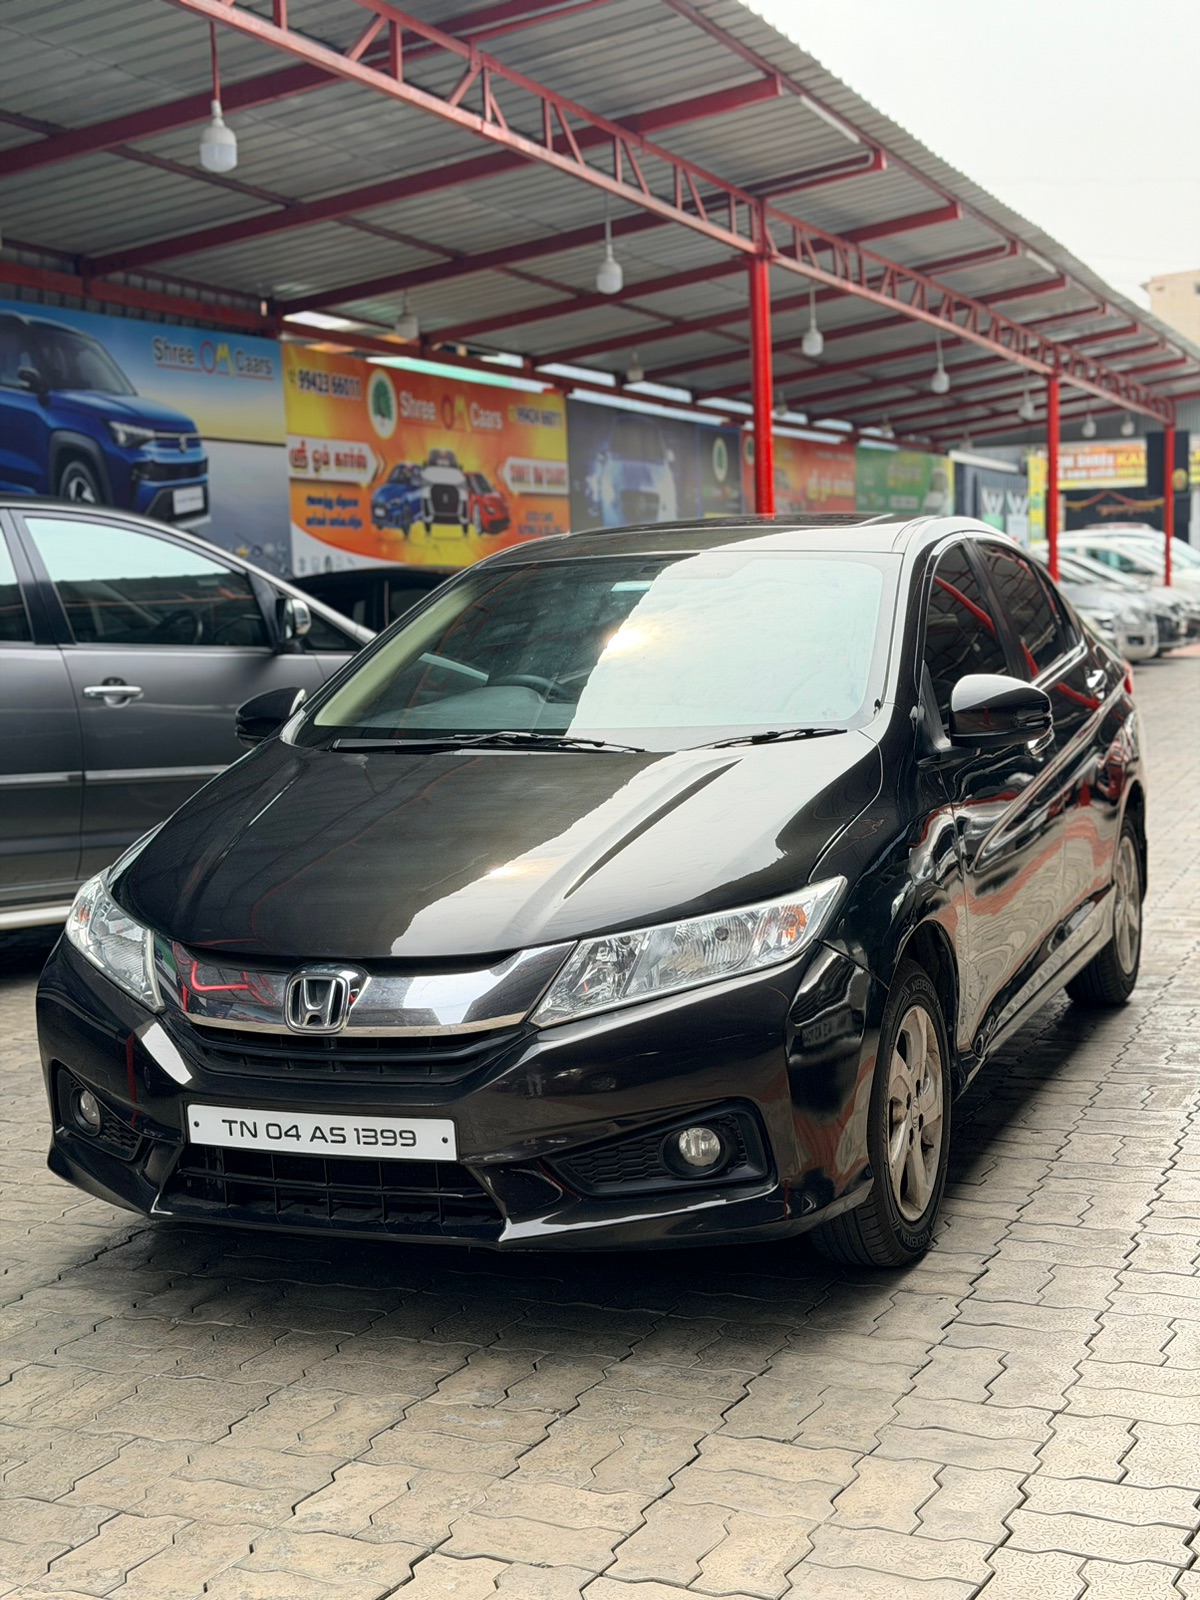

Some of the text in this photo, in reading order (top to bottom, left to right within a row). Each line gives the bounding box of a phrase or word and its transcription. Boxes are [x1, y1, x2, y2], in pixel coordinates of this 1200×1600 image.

[153, 338, 195, 365] Shree
[236, 350, 273, 375] Caars
[401, 392, 436, 420] Shree
[470, 402, 503, 430] Caars
[222, 1119, 417, 1147] TN 04 AS 1399
